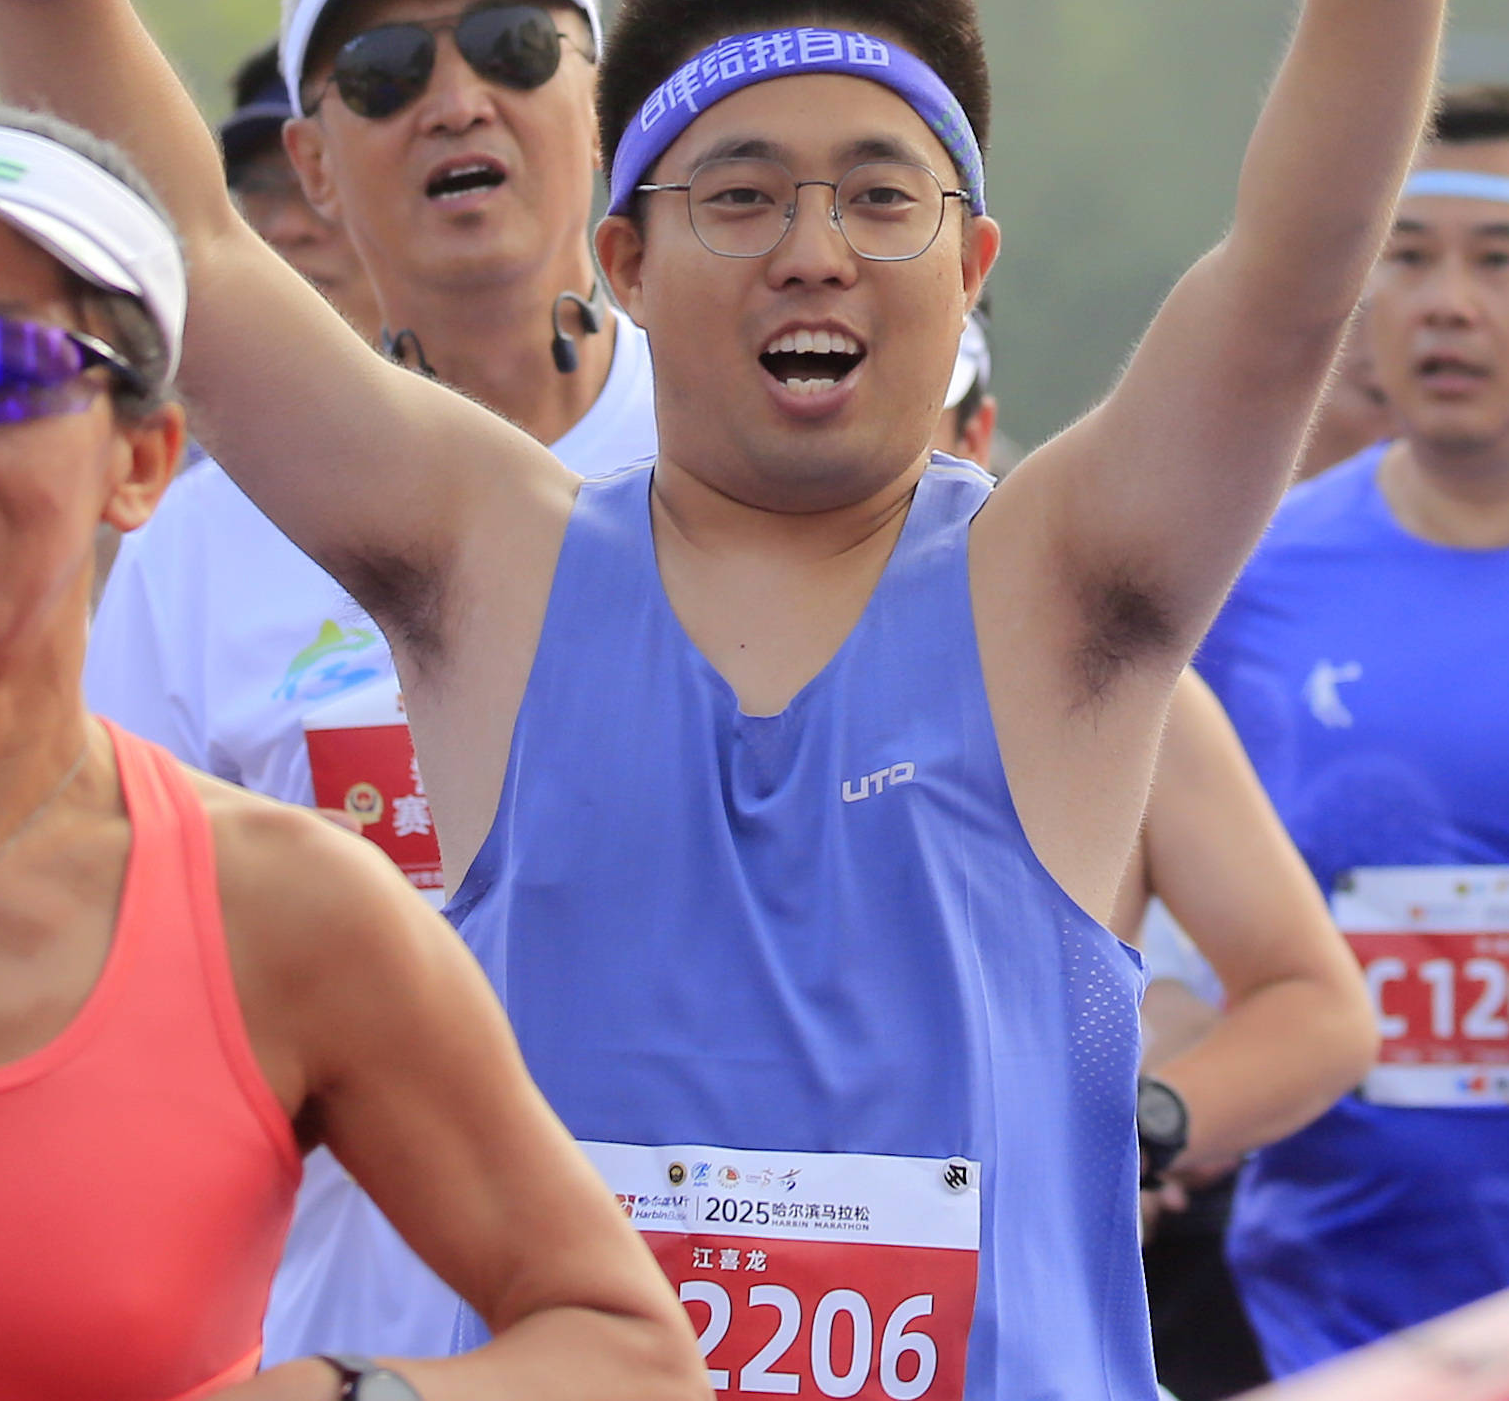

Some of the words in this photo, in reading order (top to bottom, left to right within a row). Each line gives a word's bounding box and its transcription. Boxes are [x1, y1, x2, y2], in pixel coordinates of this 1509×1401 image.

[641, 27, 889, 132] 自律给我自由
[842, 761, 915, 803] UTO
[392, 794, 432, 837] 赛
[705, 1197, 769, 1225] 2025
[772, 1202, 870, 1222] 哈尔滨马拉松
[772, 1218, 809, 1229] HARBIN
[814, 1221, 870, 1232] MARATHON
[692, 1246, 768, 1273] 江喜龙
